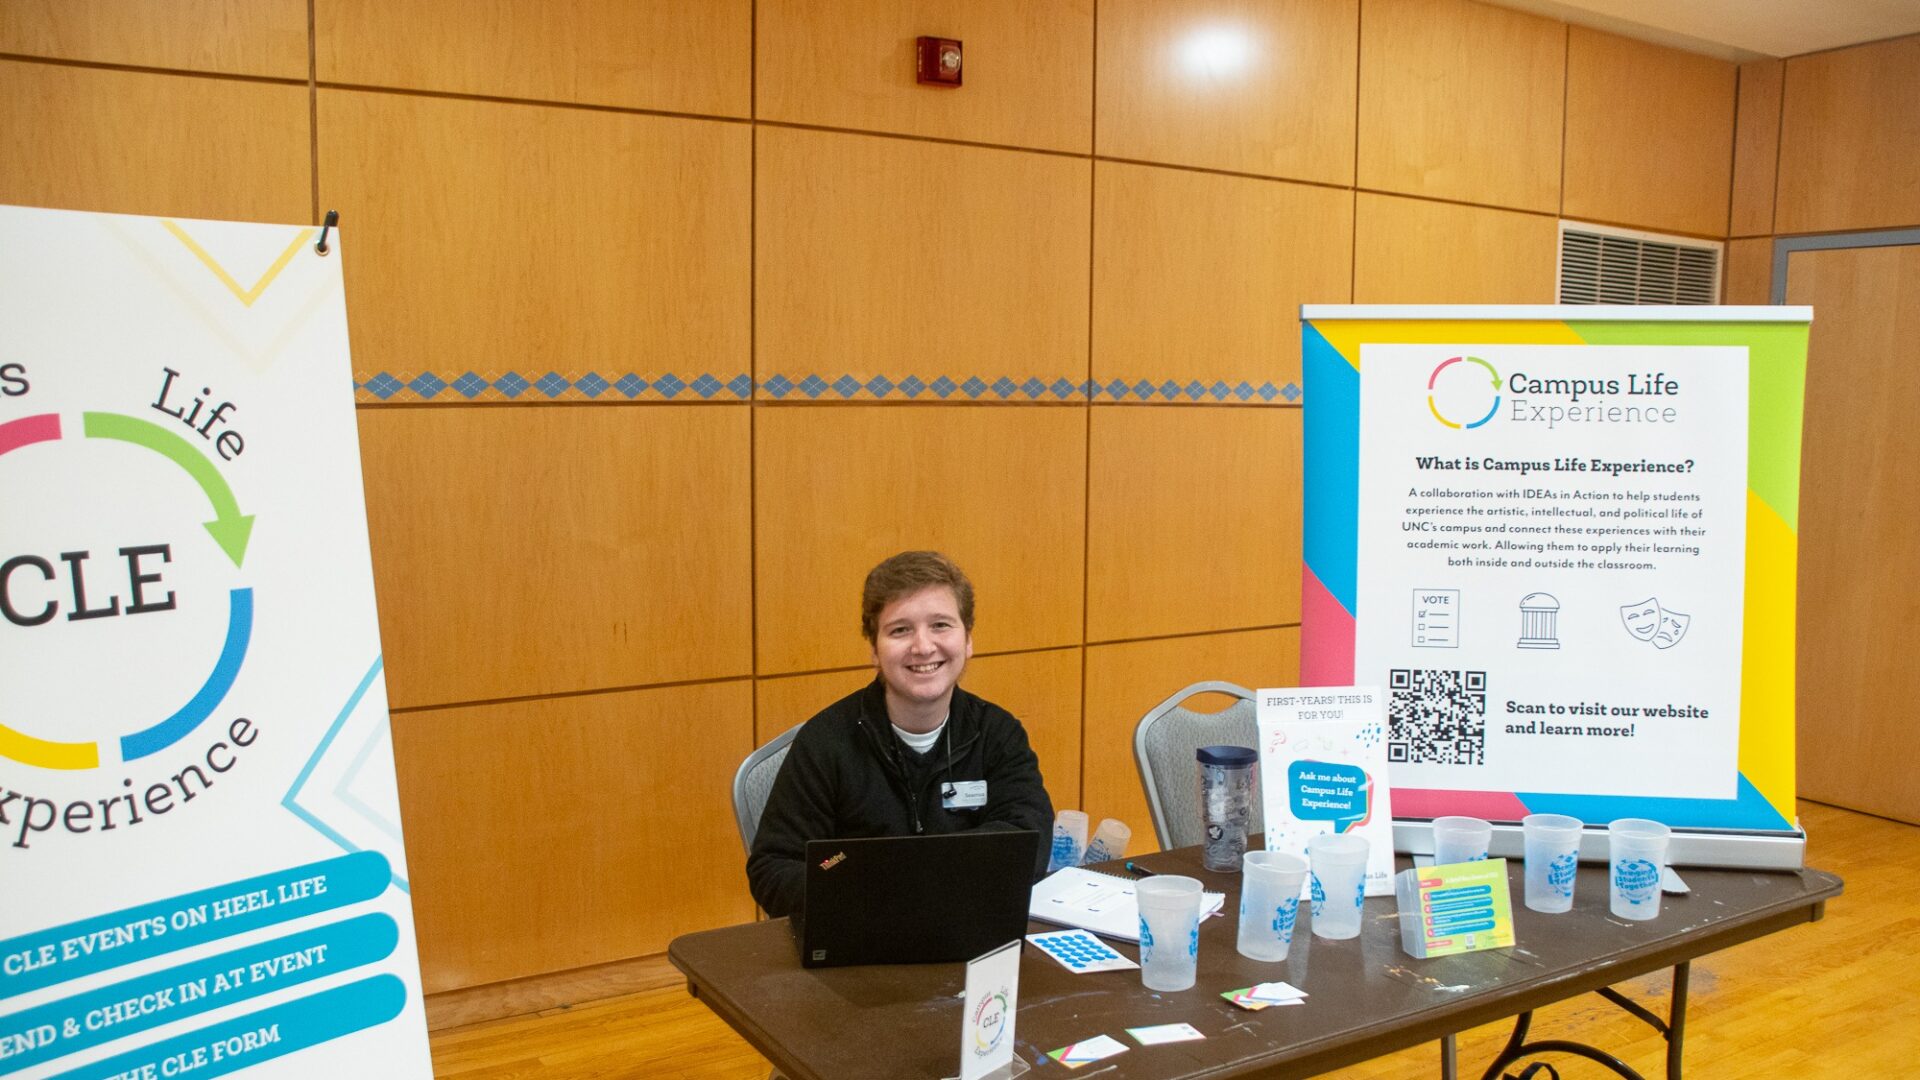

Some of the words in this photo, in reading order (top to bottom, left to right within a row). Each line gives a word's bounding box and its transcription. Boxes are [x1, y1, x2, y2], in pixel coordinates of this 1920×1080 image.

[1509, 373, 1620, 402] Campus
[1627, 373, 1679, 396] Life
[151, 366, 246, 462] Life
[1510, 400, 1678, 428] Experience
[1415, 456, 1462, 470] What
[1465, 456, 1480, 471] is
[1483, 457, 1551, 476] Campus
[1554, 457, 1587, 472] Life
[1590, 458, 1695, 477] Experience?
[1409, 488, 1417, 497] A
[1420, 488, 1493, 499] collaboration
[1496, 489, 1520, 499] with
[1523, 489, 1558, 500] IDEAs
[1561, 490, 1570, 500] in
[1573, 490, 1610, 501] Action
[1613, 492, 1624, 501] to
[1626, 491, 1650, 503] help
[1653, 491, 1701, 502] students
[1406, 506, 1463, 518] experience
[1467, 506, 1484, 516] the
[1487, 507, 1529, 518] artistic,
[1532, 507, 1596, 518] intellectual,
[1599, 508, 1621, 518] and
[1624, 508, 1668, 521] political
[1671, 508, 1689, 519] life
[1691, 509, 1703, 519] of
[1402, 522, 1437, 533] UNC's
[1440, 525, 1482, 536] campus
[1485, 523, 1506, 533] and
[1509, 524, 1552, 534] connect
[1554, 524, 1583, 535] these
[1586, 526, 1651, 538] experiences
[1653, 526, 1677, 537] with
[1680, 526, 1706, 537] their
[1407, 539, 1459, 550] academic
[1462, 540, 1492, 551] work.
[1495, 540, 1545, 554] Allowing
[1547, 541, 1574, 552] them
[1577, 543, 1588, 552] to
[1591, 542, 1623, 555] apply
[1625, 543, 1650, 553] their
[1653, 543, 1700, 556] learning
[1448, 556, 1474, 567] both
[1476, 557, 1508, 568] inside
[1511, 558, 1532, 568] and
[1535, 558, 1574, 569] outside
[1577, 559, 1595, 569] the
[1597, 559, 1657, 570] classroom.
[0, 544, 177, 627] CLE
[1421, 595, 1450, 605] VOTE
[1337, 695, 1361, 704] THIS
[1363, 694, 1373, 703] IS
[1298, 710, 1318, 720] FOR
[1319, 710, 1344, 719] YOU!
[1506, 701, 1543, 715] Scan
[1549, 703, 1566, 716] to
[1569, 702, 1607, 716] visit
[1611, 706, 1640, 717] our
[1643, 703, 1710, 719] website
[1505, 721, 1537, 735] and
[1540, 721, 1584, 736] learn
[1587, 722, 1635, 737] more!
[0, 716, 259, 849] xperience
[1299, 771, 1316, 781] Ask
[1317, 774, 1331, 782] me
[1332, 773, 1357, 784] about
[1301, 785, 1336, 797] Campus
[1336, 787, 1354, 797] Life
[1302, 798, 1352, 810] Experience!
[3, 944, 57, 976] CLE
[62, 915, 167, 961] EVENTS
[171, 904, 207, 931] ON
[212, 889, 275, 921] HEEL
[278, 875, 328, 903] LIFE
[0, 1024, 57, 1060] END
[62, 1017, 81, 1038] &
[85, 986, 175, 1031] CHECK
[179, 977, 208, 1004] IN
[212, 966, 246, 995] AT
[250, 943, 328, 985] EVENT
[983, 1012, 1000, 1029] CLE
[160, 1046, 208, 1076] CLE
[212, 1023, 282, 1064] FORM
